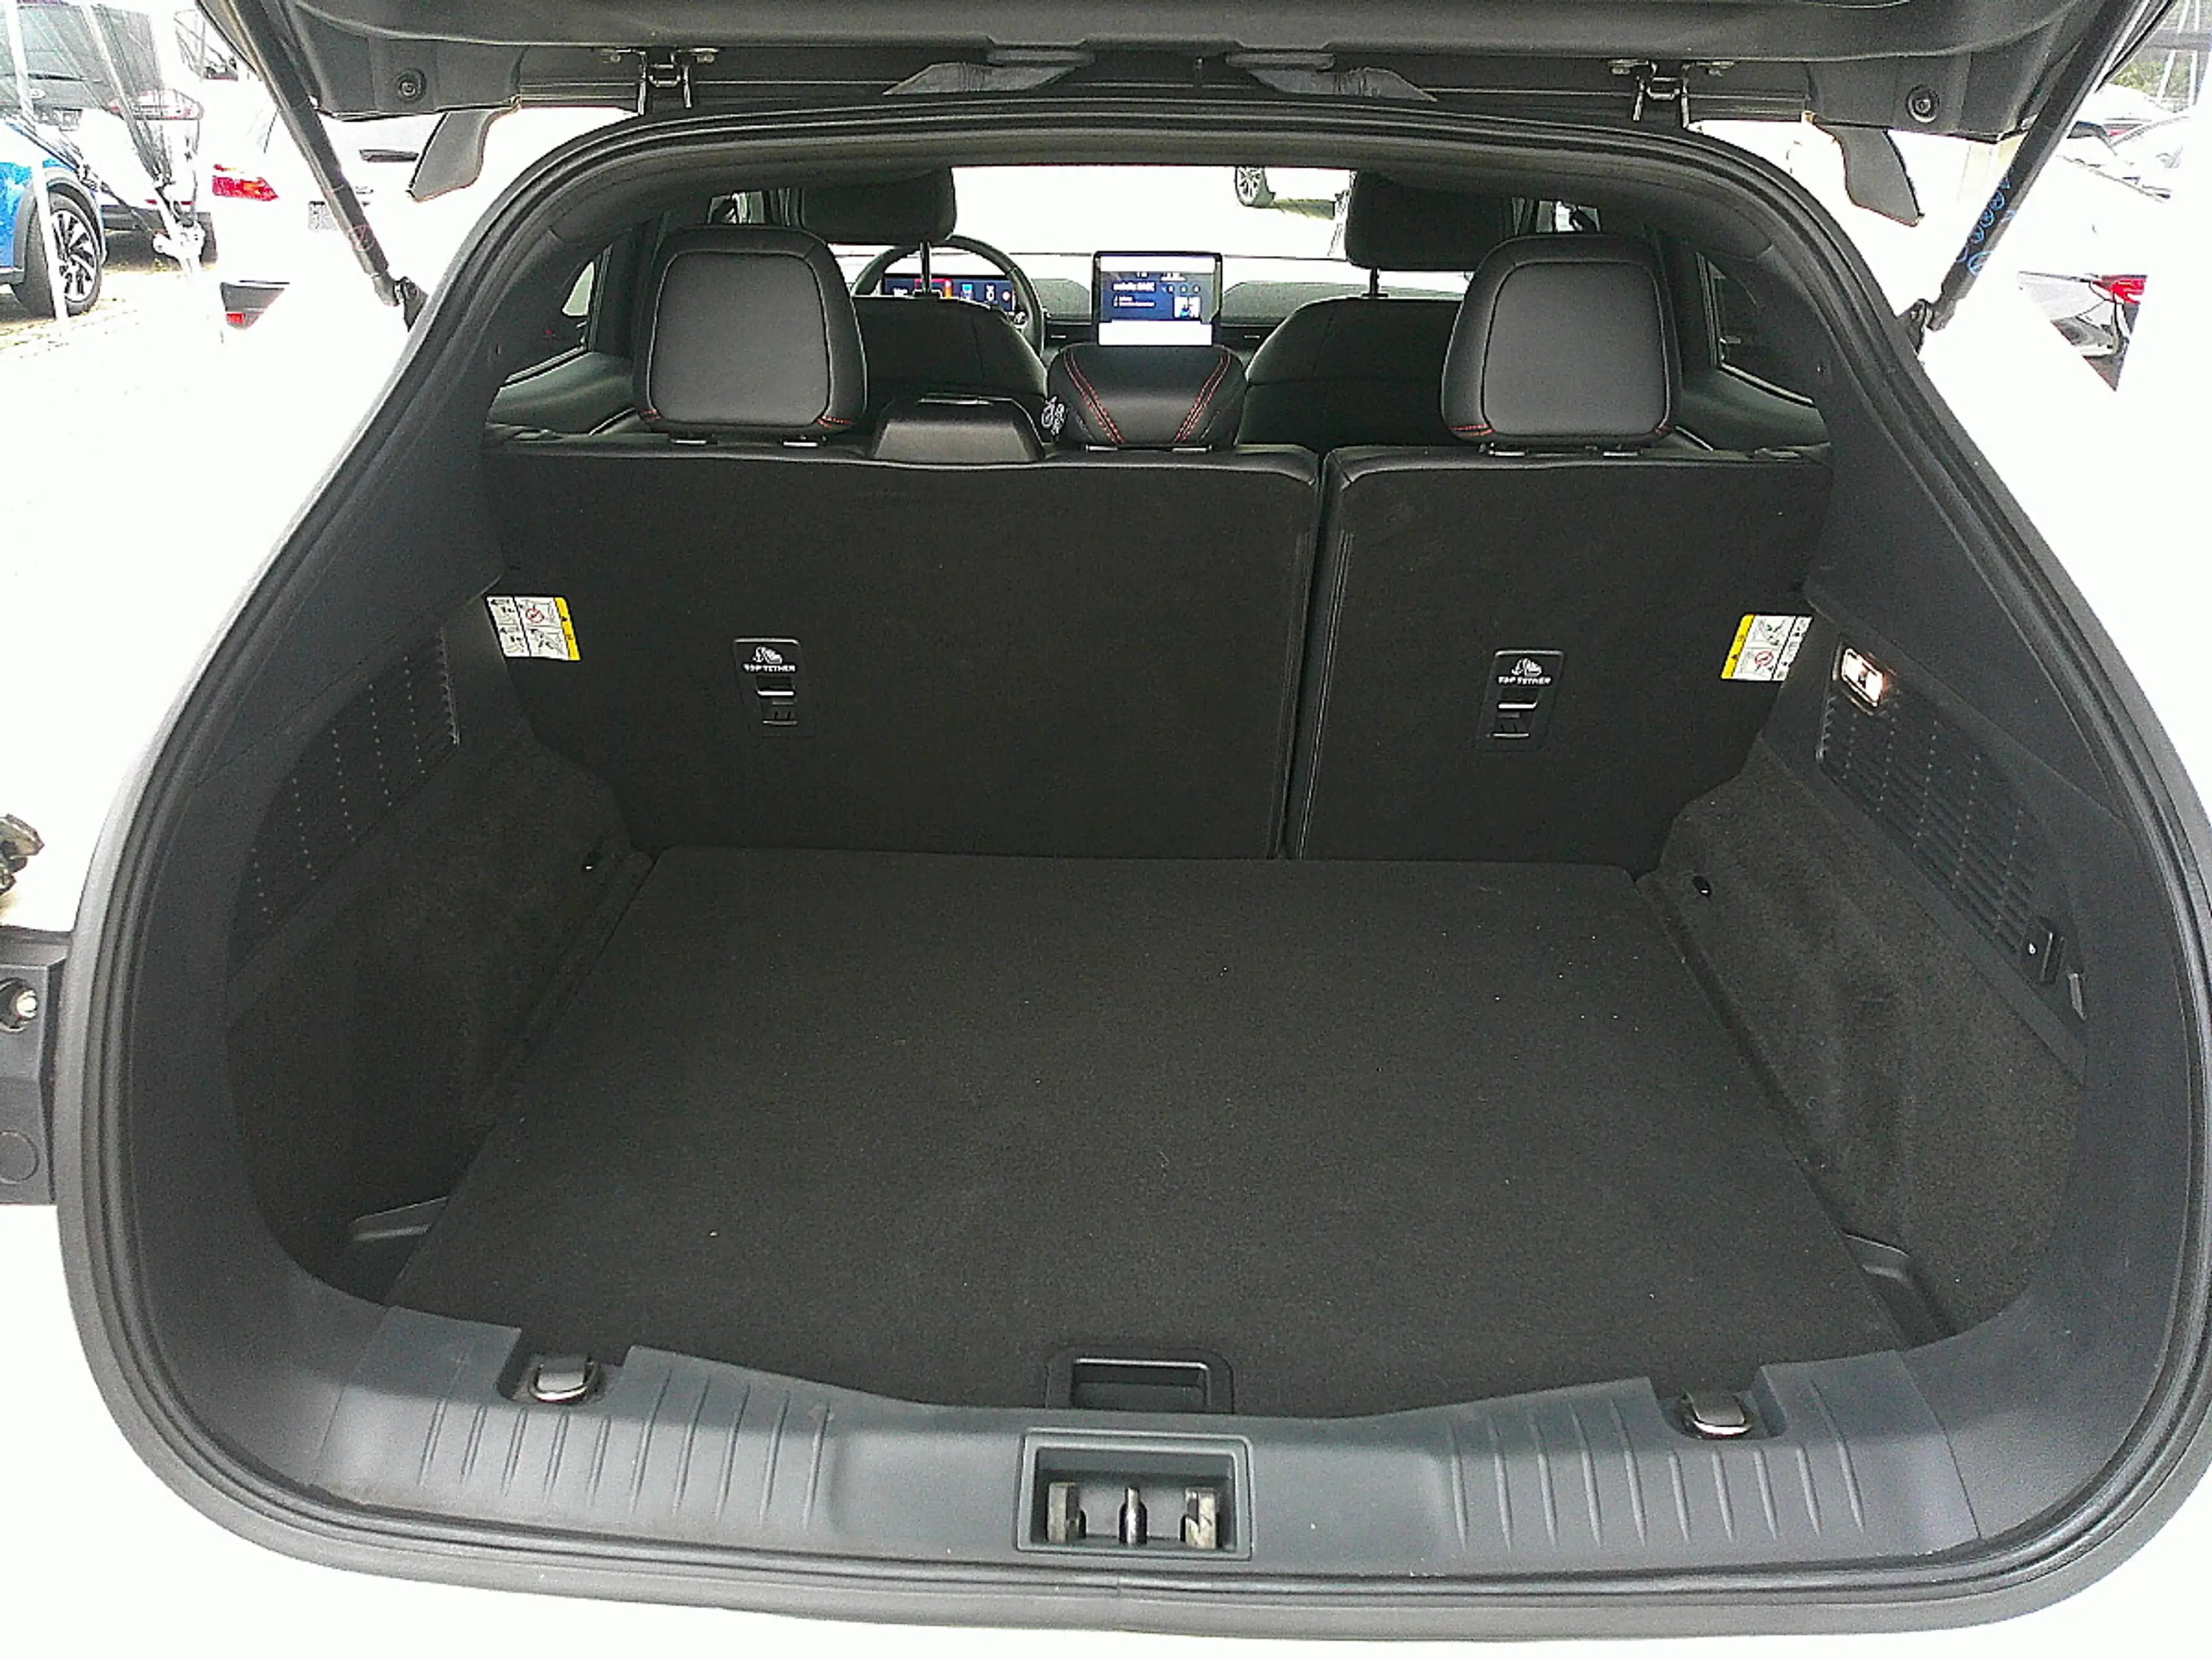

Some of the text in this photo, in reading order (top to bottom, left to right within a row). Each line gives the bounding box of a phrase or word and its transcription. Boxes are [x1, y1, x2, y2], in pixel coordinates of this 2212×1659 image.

[743, 663, 796, 672] TOP TETHER
[1498, 676, 1552, 685] TOP TETHER
